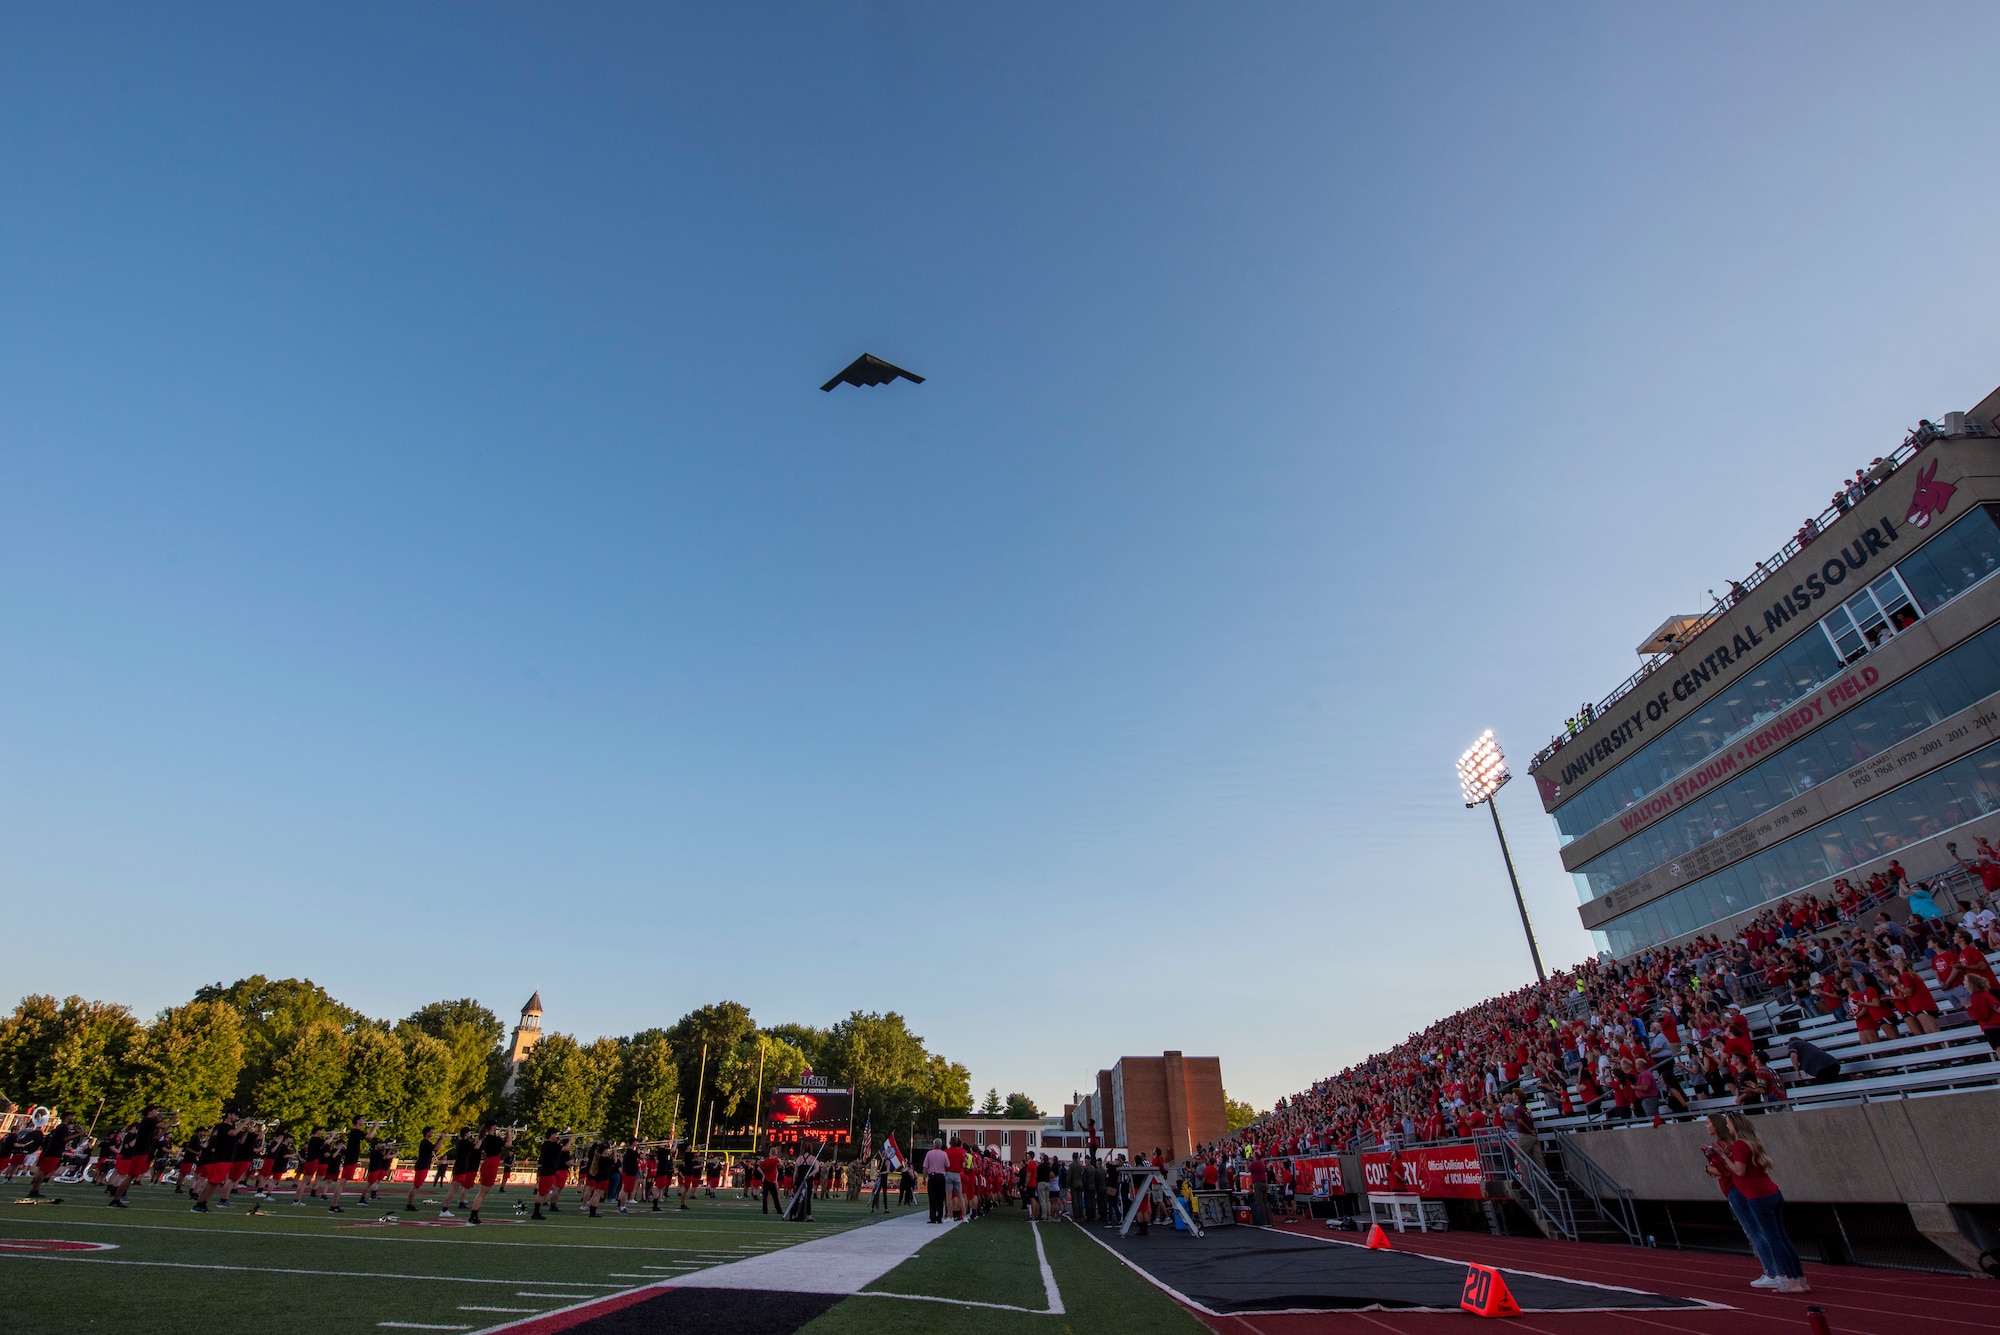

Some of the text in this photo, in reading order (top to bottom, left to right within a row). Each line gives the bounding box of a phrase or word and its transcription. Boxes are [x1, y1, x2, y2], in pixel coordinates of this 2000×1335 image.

[1561, 516, 1899, 785] UNIVERSITY OF CENTRAL MISSOURI
[1619, 666, 1879, 832] WALTON STADIUM KENNEDY FIELD
[1852, 711, 1998, 788] 1950 1968 1970 2001 2011 2014
[1848, 754, 1890, 780] BOWL GAMES
[1725, 839, 1738, 851] 1915
[1740, 831, 1755, 843] 1926
[1774, 816, 1790, 828] 1970
[1791, 806, 1808, 819] 1983
[800, 1076, 828, 1086] UCM
[1366, 1162, 1418, 1186] COURY
[1428, 1160, 1444, 1170] Official
[1444, 1160, 1464, 1170] Collision
[1445, 1174, 1450, 1184] of
[1464, 1268, 1492, 1310] 20
